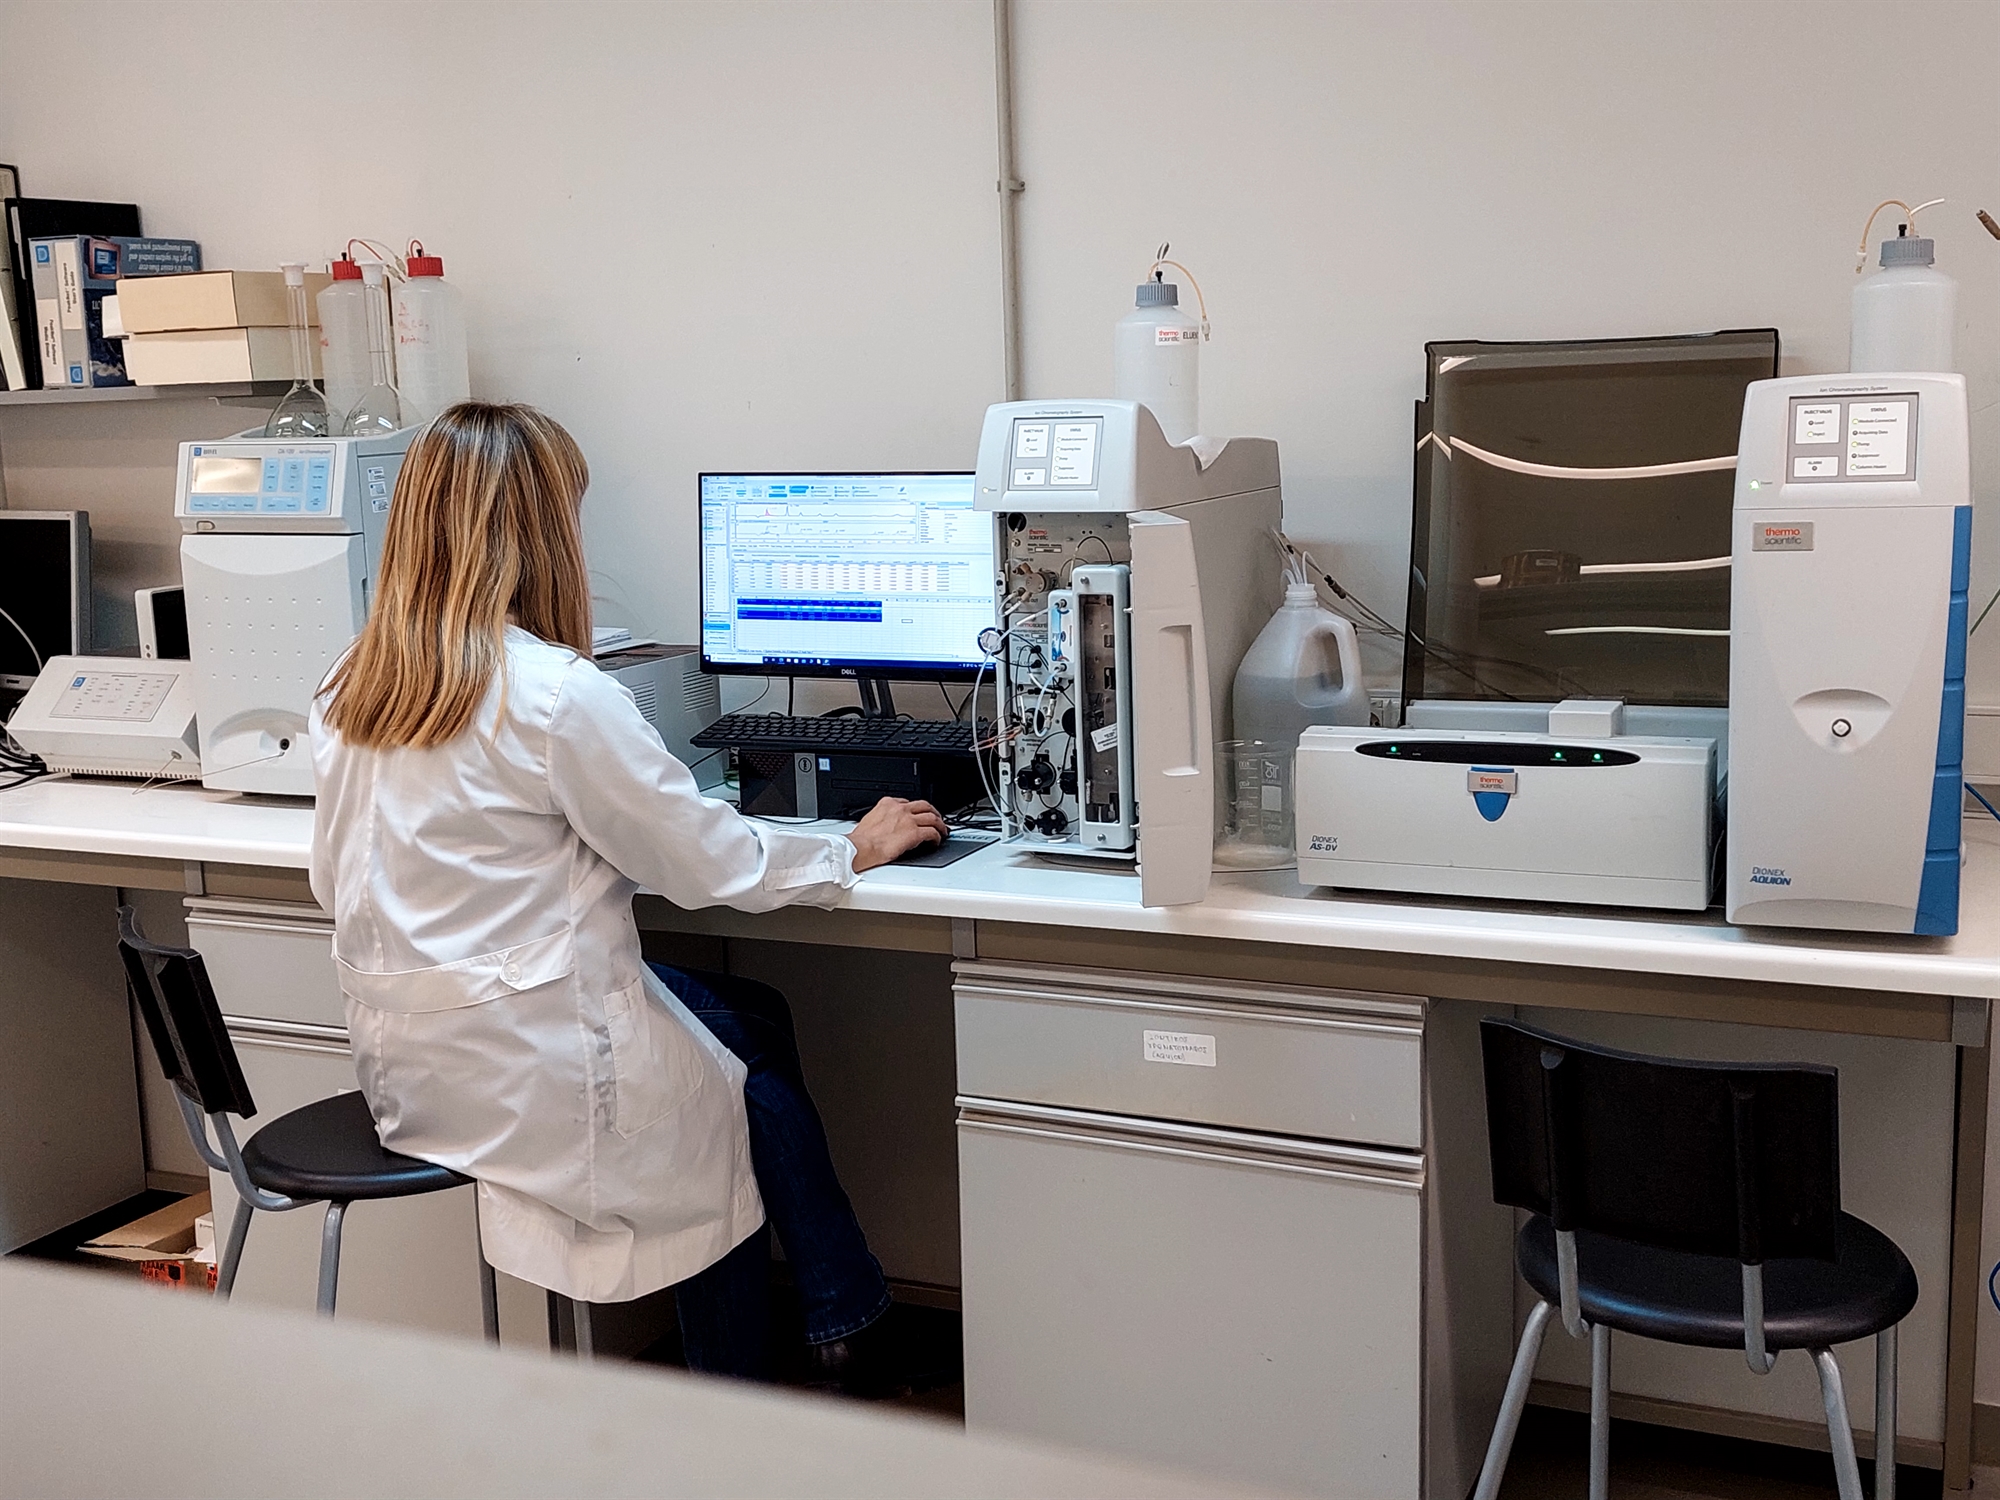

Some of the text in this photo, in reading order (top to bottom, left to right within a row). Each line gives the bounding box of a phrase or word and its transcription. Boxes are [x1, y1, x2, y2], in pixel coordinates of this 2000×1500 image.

[1765, 528, 1800, 536] thermo
[1765, 537, 1801, 545] scientific
[1311, 835, 1338, 844] DIONEX
[1309, 843, 1338, 851] AS-DV
[1752, 866, 1785, 876] DIONEX
[1750, 875, 1791, 885] AQUION
